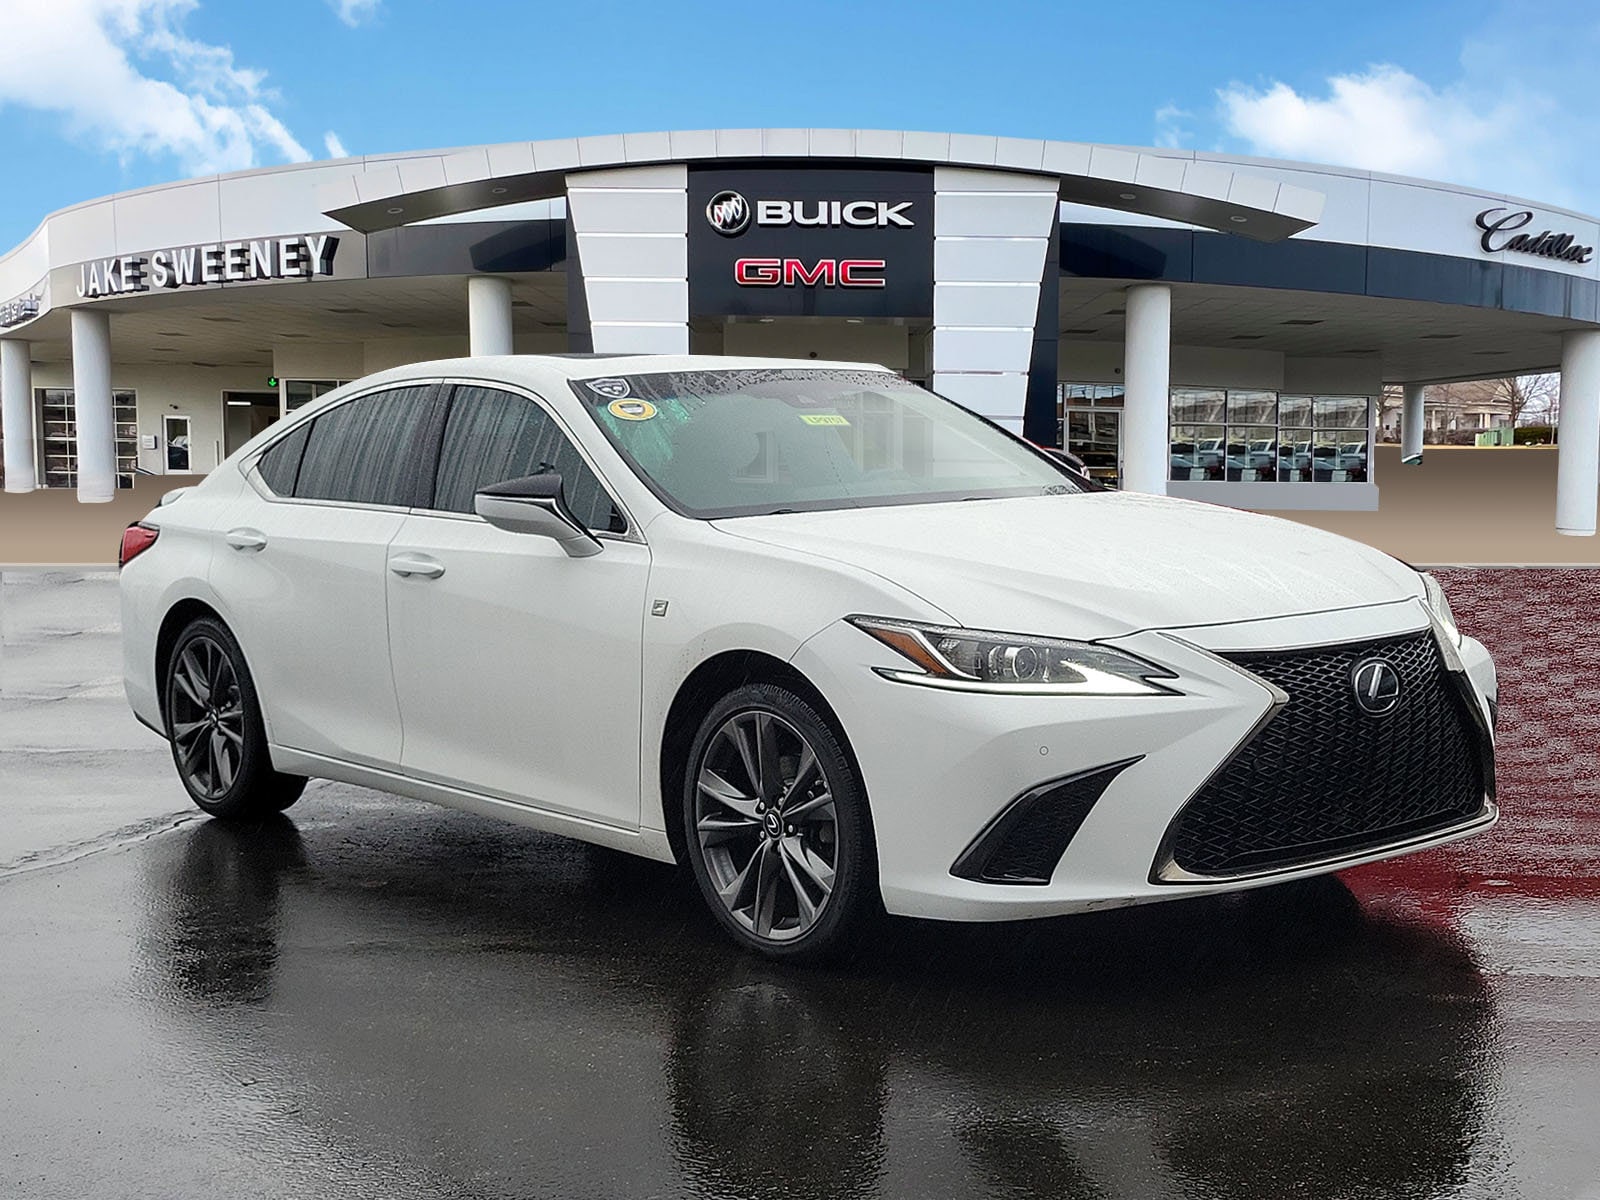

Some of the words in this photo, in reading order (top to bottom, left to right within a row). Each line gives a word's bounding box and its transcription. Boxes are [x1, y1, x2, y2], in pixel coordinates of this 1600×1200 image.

[757, 200, 915, 227] BUICK
[1475, 207, 1593, 264] Cadillac
[76, 255, 143, 298] JAKE
[151, 235, 334, 288] SWEENEY
[734, 257, 886, 288] GMC
